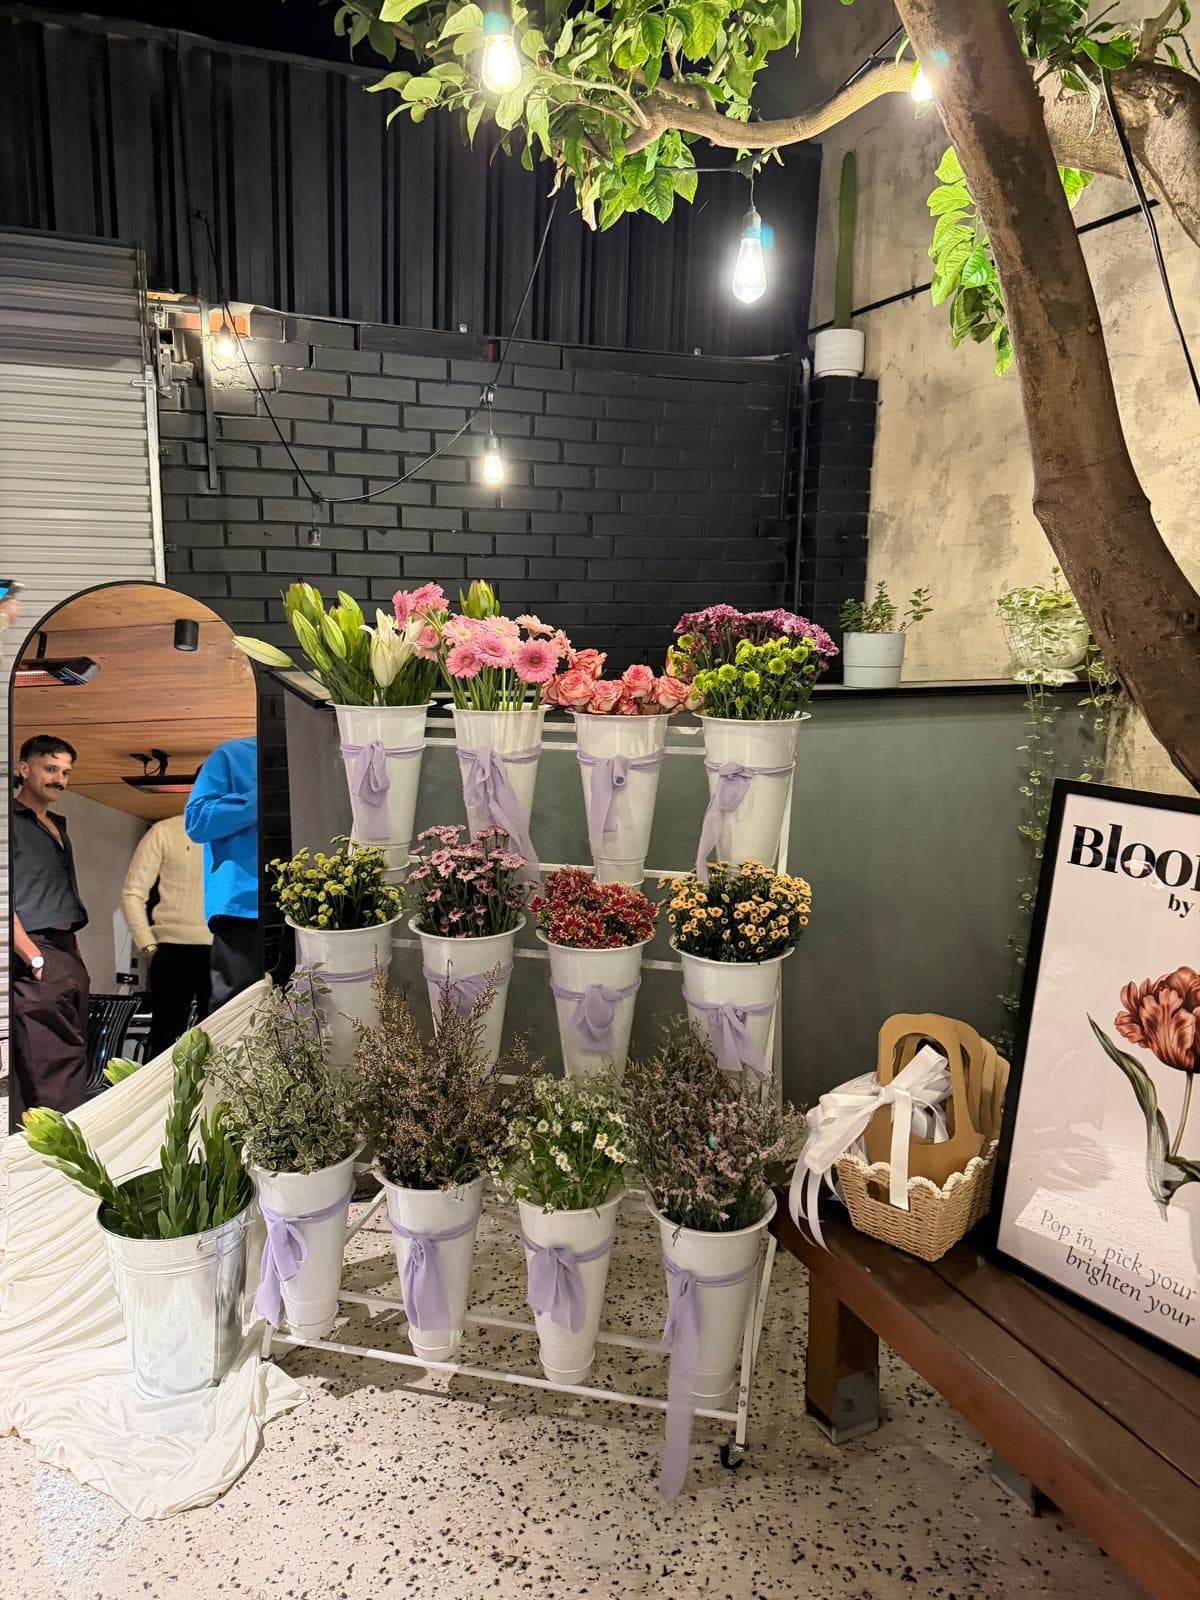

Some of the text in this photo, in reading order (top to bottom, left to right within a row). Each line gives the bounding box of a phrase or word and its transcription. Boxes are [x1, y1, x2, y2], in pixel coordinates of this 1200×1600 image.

[1067, 823, 1200, 892] Bloo
[1168, 893, 1195, 918] by
[1041, 1209, 1197, 1300] Pop in, pick your
[1066, 1245, 1195, 1326] brighten your
